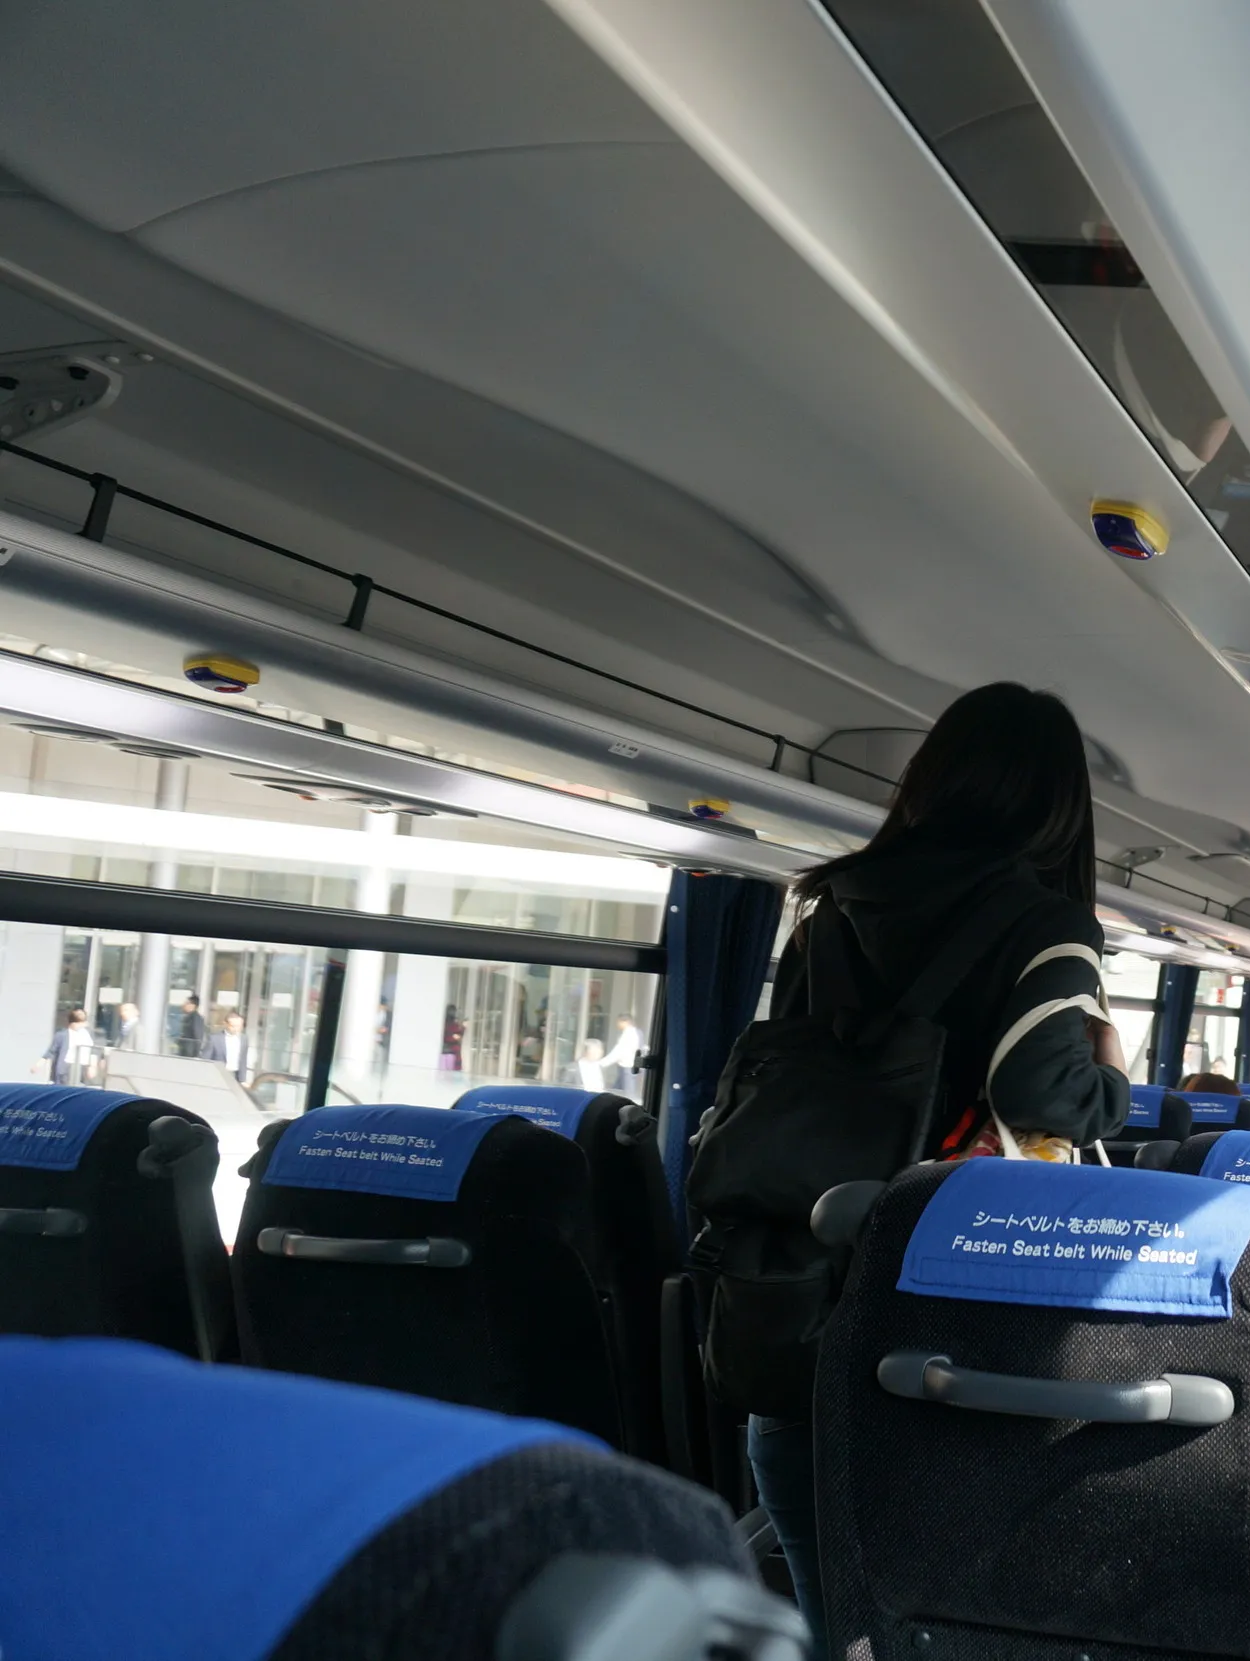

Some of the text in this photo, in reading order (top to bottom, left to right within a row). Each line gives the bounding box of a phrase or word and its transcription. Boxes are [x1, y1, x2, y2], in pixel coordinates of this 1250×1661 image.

[298, 1145, 444, 1167] Fasten Seat belt While Seated
[972, 1211, 1185, 1239] シートベルトをお締め下さい。
[951, 1235, 1197, 1265] Fasten Seat belt While Seated
